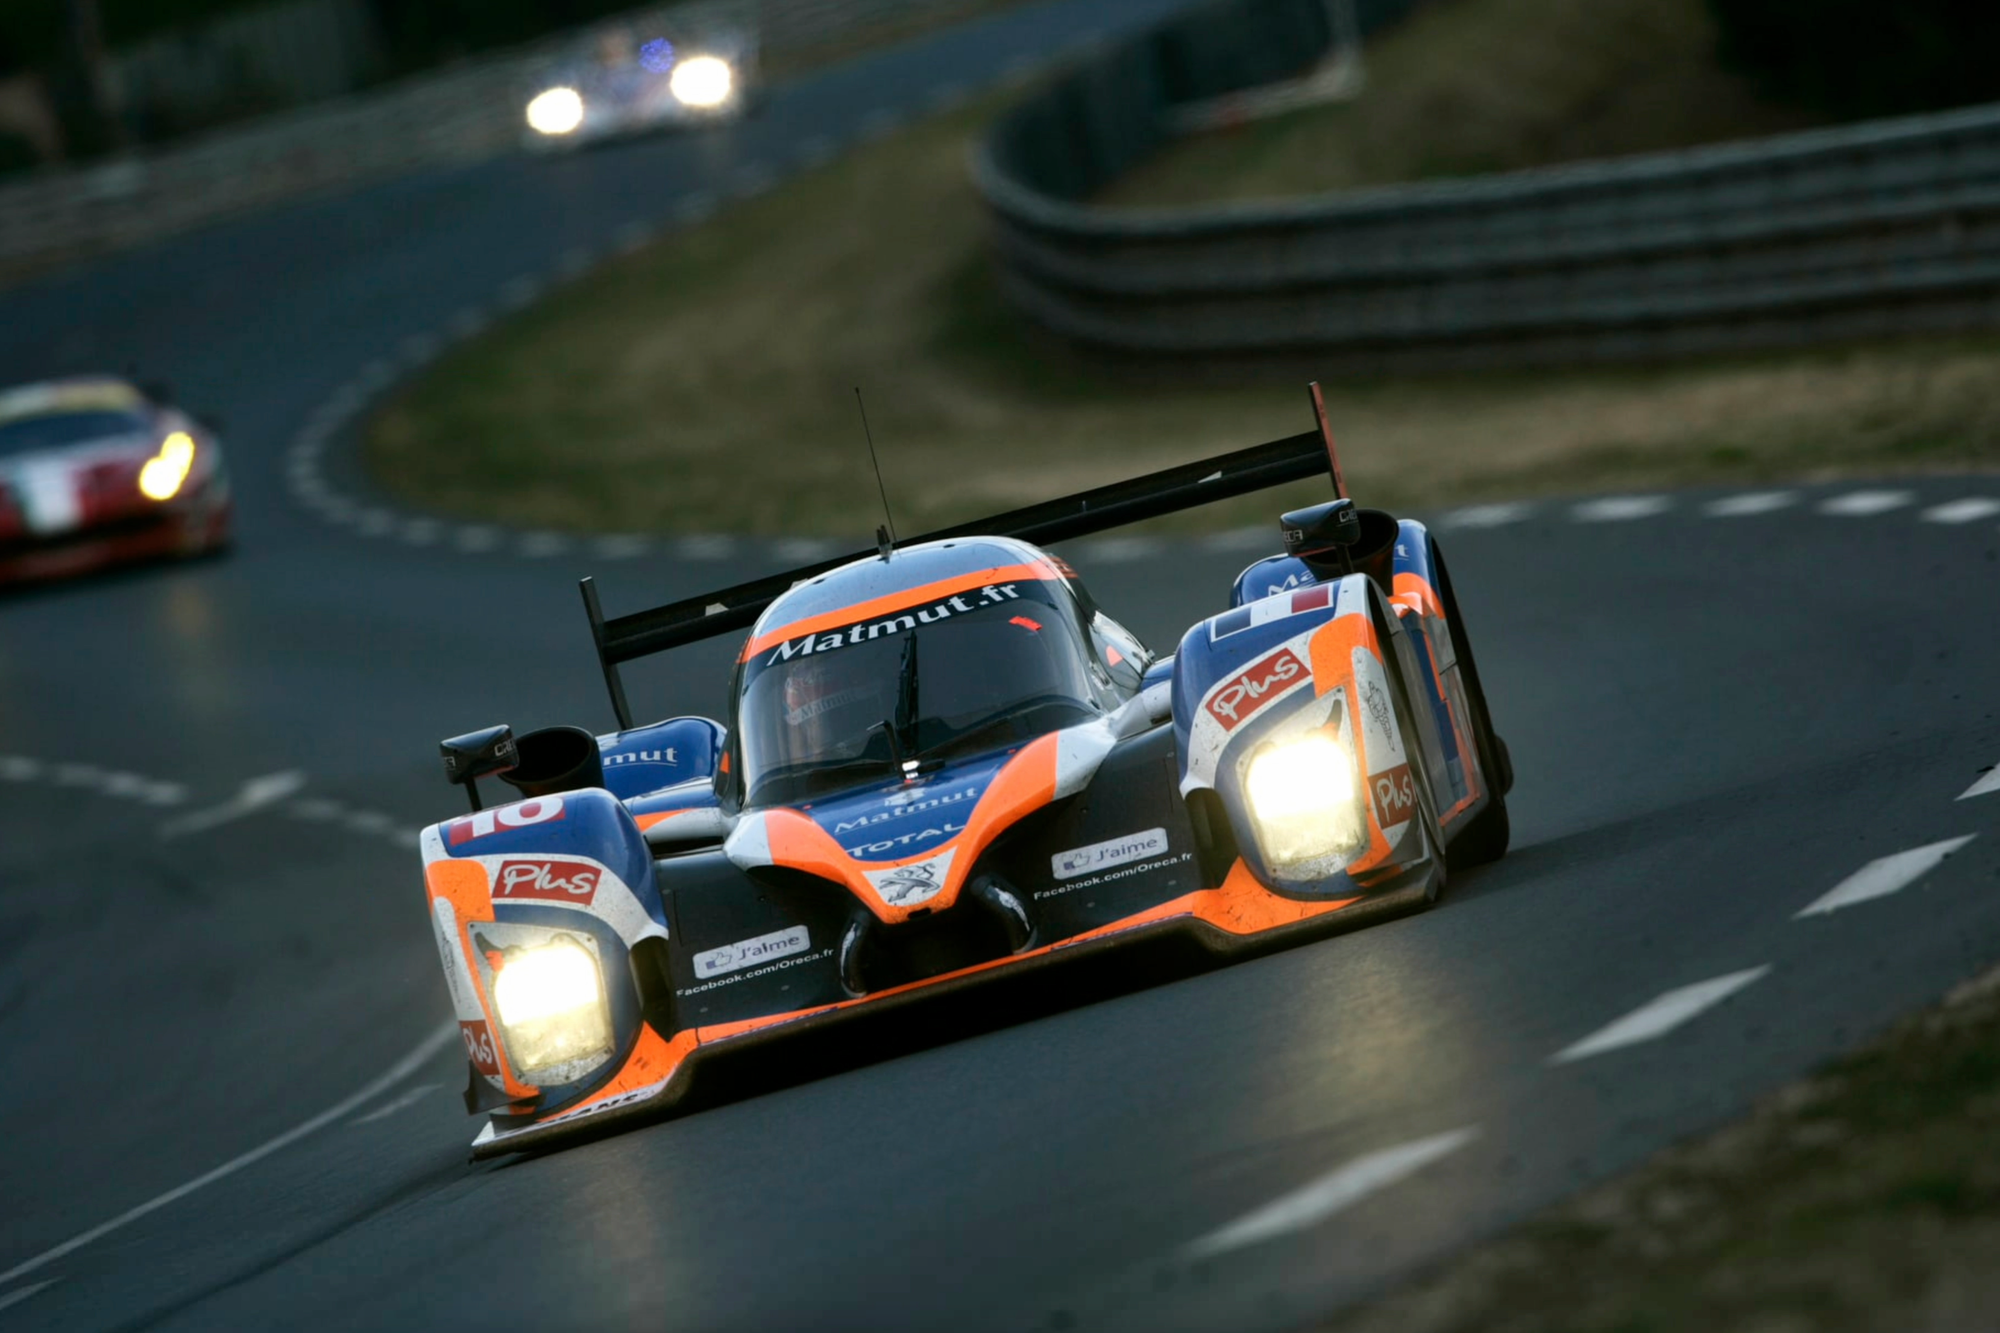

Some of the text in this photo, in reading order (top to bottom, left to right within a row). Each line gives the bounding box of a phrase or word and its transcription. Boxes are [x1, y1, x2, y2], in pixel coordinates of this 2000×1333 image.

[766, 582, 1019, 666] Matmut.fr
[1212, 655, 1300, 721] Plus
[603, 747, 678, 766] mut
[834, 787, 978, 833] Matmut
[1375, 770, 1412, 823] Plus
[845, 823, 967, 857] TOTAL
[1096, 837, 1158, 863] J'aime
[503, 863, 596, 896] Plus
[1033, 852, 1193, 900] Facebook.com/Oreca.fr
[676, 949, 834, 998] Facebook.com/Oreca.fr
[462, 1025, 493, 1065] Plus
